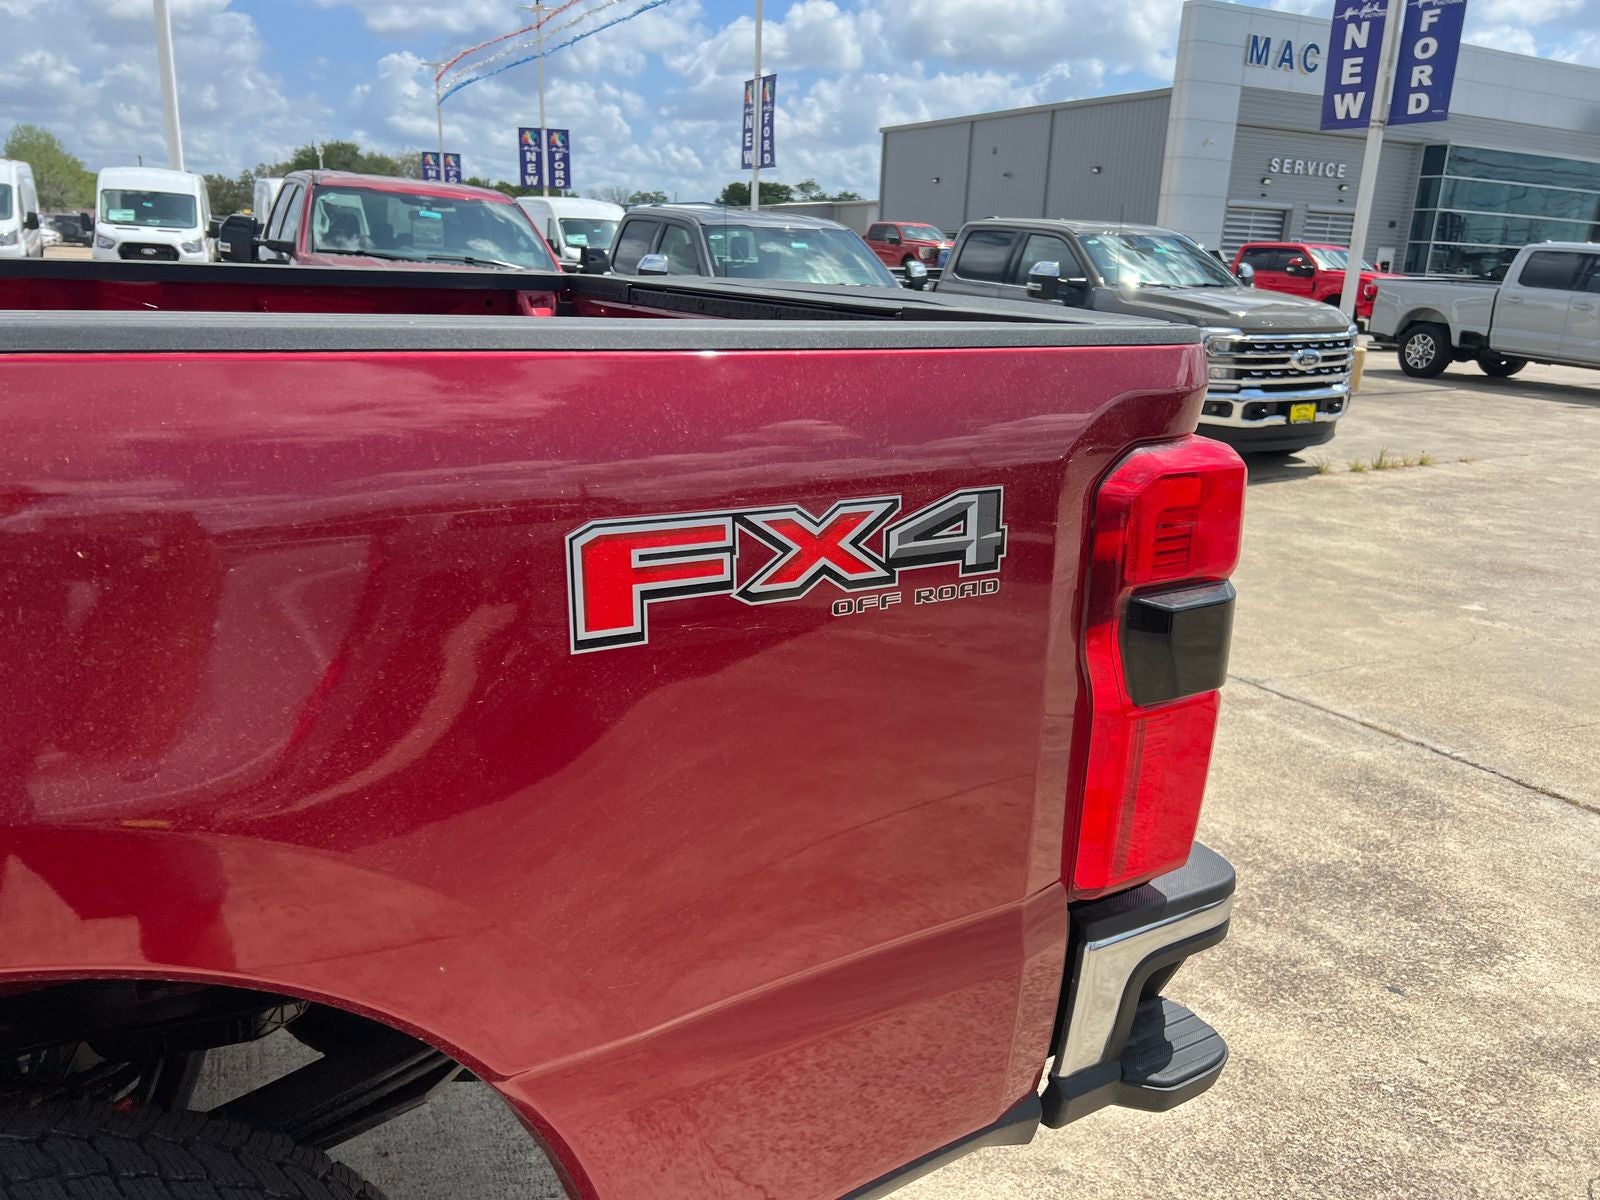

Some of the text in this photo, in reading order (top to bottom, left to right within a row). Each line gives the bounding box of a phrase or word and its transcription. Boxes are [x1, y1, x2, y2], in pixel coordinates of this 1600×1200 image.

[1247, 34, 1321, 74] MAC
[1334, 21, 1370, 120] NEW
[1407, 8, 1442, 115] FORD
[763, 112, 772, 165] FORD
[524, 150, 539, 186] NEW
[553, 152, 566, 187] FORD
[1269, 157, 1347, 179] SERVICE
[565, 485, 1008, 654] FX4
[831, 578, 1000, 617] OFF ROAD
